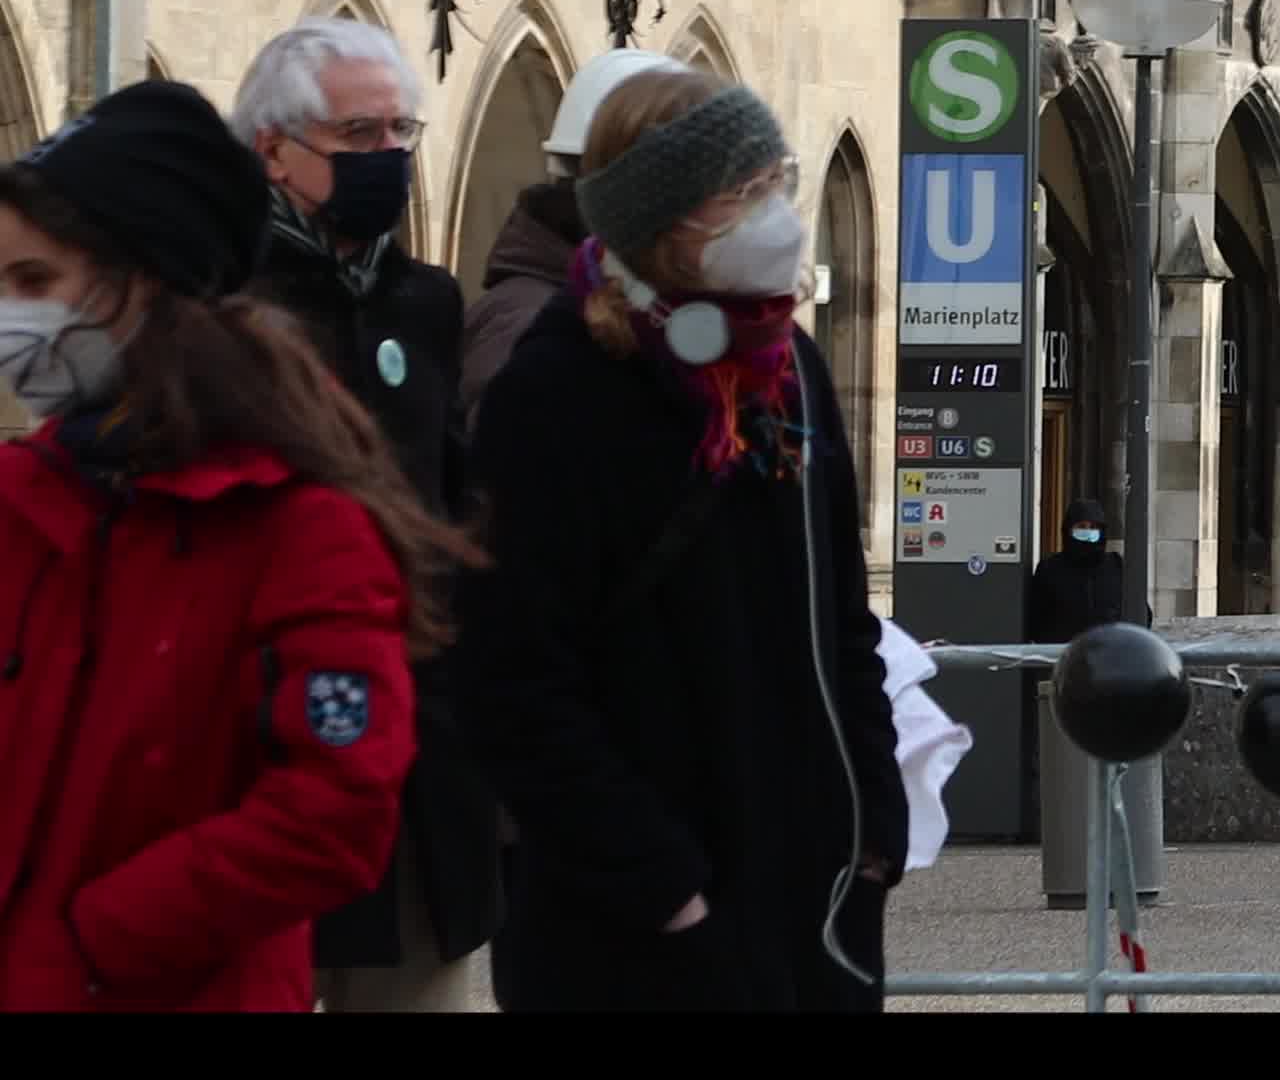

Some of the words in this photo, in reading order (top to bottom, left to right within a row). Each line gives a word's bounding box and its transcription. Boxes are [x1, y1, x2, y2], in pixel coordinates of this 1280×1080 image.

[927, 39, 1001, 135] S
[925, 169, 997, 264] U
[904, 306, 1020, 329] Marienplatz
[932, 364, 998, 387] 11:10
[897, 406, 934, 418] Eingang
[904, 439, 926, 454] U3
[941, 439, 964, 454] U6
[975, 437, 993, 457] S
